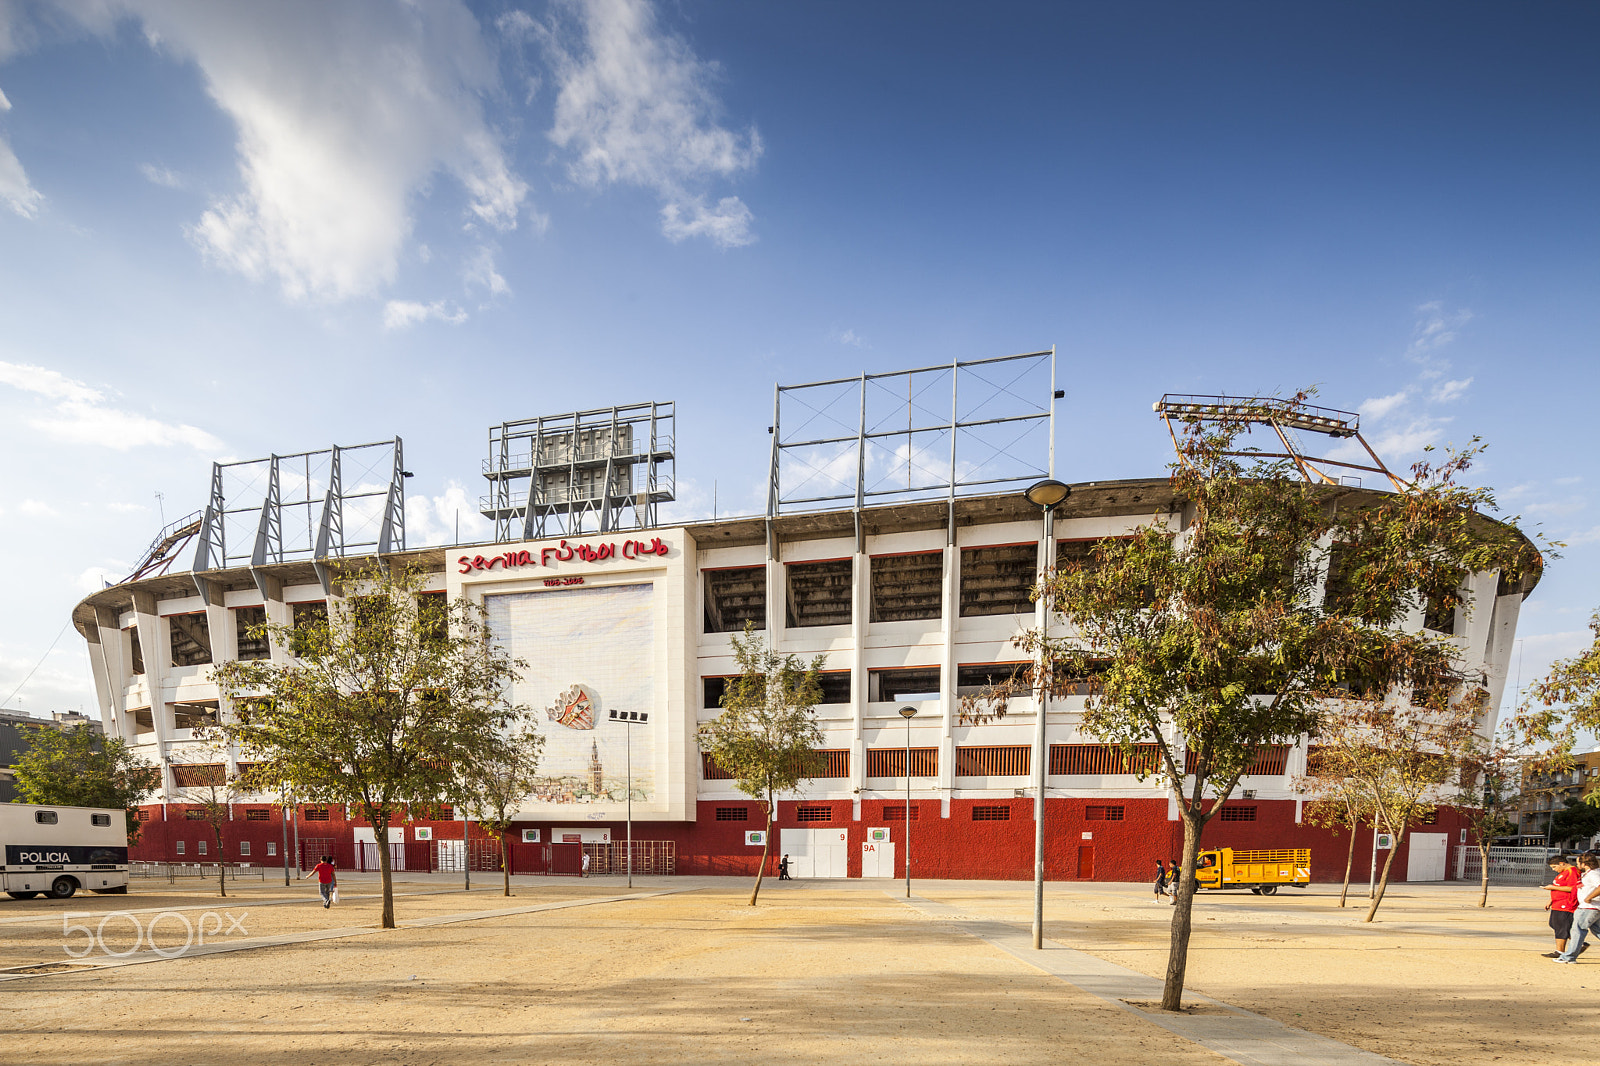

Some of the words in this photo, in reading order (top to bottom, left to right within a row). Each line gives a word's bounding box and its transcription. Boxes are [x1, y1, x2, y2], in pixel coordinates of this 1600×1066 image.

[458, 549, 536, 574] Sevilla
[541, 540, 615, 567] Fútbol
[622, 537, 669, 560] Club
[603, 833, 608, 841] 8
[840, 833, 846, 841] 9
[863, 844, 876, 852] 9A
[19, 852, 71, 863] POLICIA
